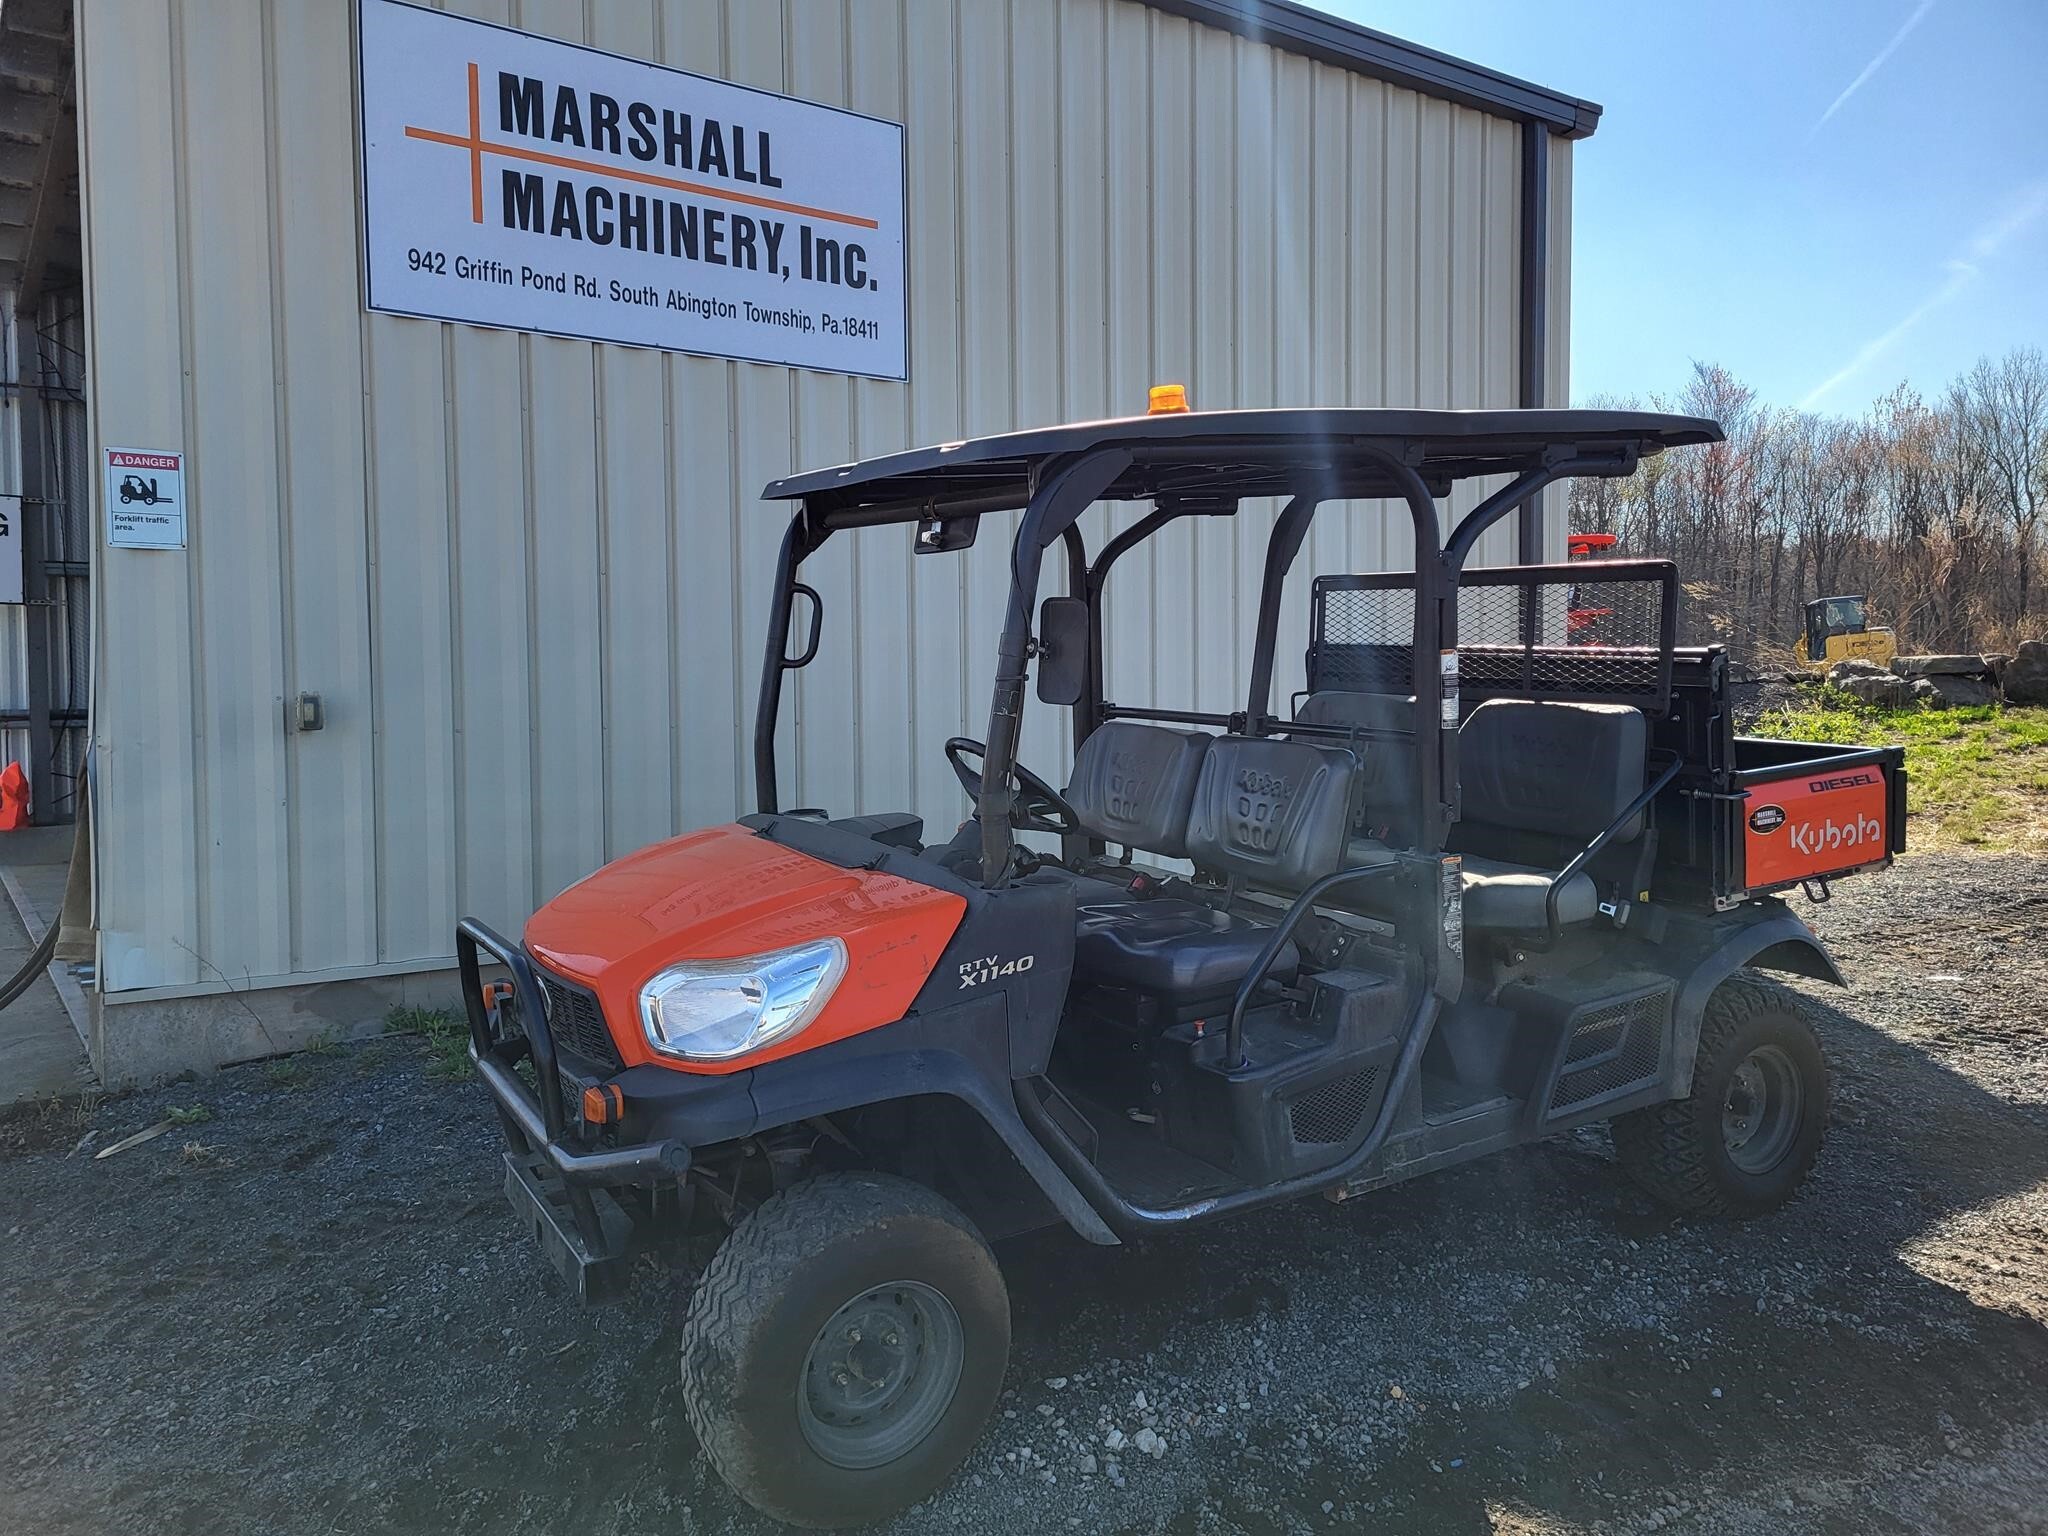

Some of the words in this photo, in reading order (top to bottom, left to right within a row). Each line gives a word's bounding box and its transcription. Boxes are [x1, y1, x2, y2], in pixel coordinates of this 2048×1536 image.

[498, 71, 782, 188] MARSHALL
[502, 169, 790, 283] MACHINERY,
[800, 225, 878, 291] Inc.
[408, 248, 447, 275] 942
[455, 255, 513, 285] Griffin
[521, 266, 566, 293] Pond
[574, 274, 602, 299] Rd.
[609, 280, 659, 307] South
[666, 289, 737, 319] Abington
[743, 301, 816, 335] Township,
[125, 456, 175, 468] DANGER
[114, 514, 144, 524] Forklift
[145, 516, 170, 525] traffic
[1808, 774, 1880, 793] DIESEL
[1790, 813, 1881, 855] Kubota
[958, 955, 1034, 990] X1140
[959, 954, 999, 974] RTV
